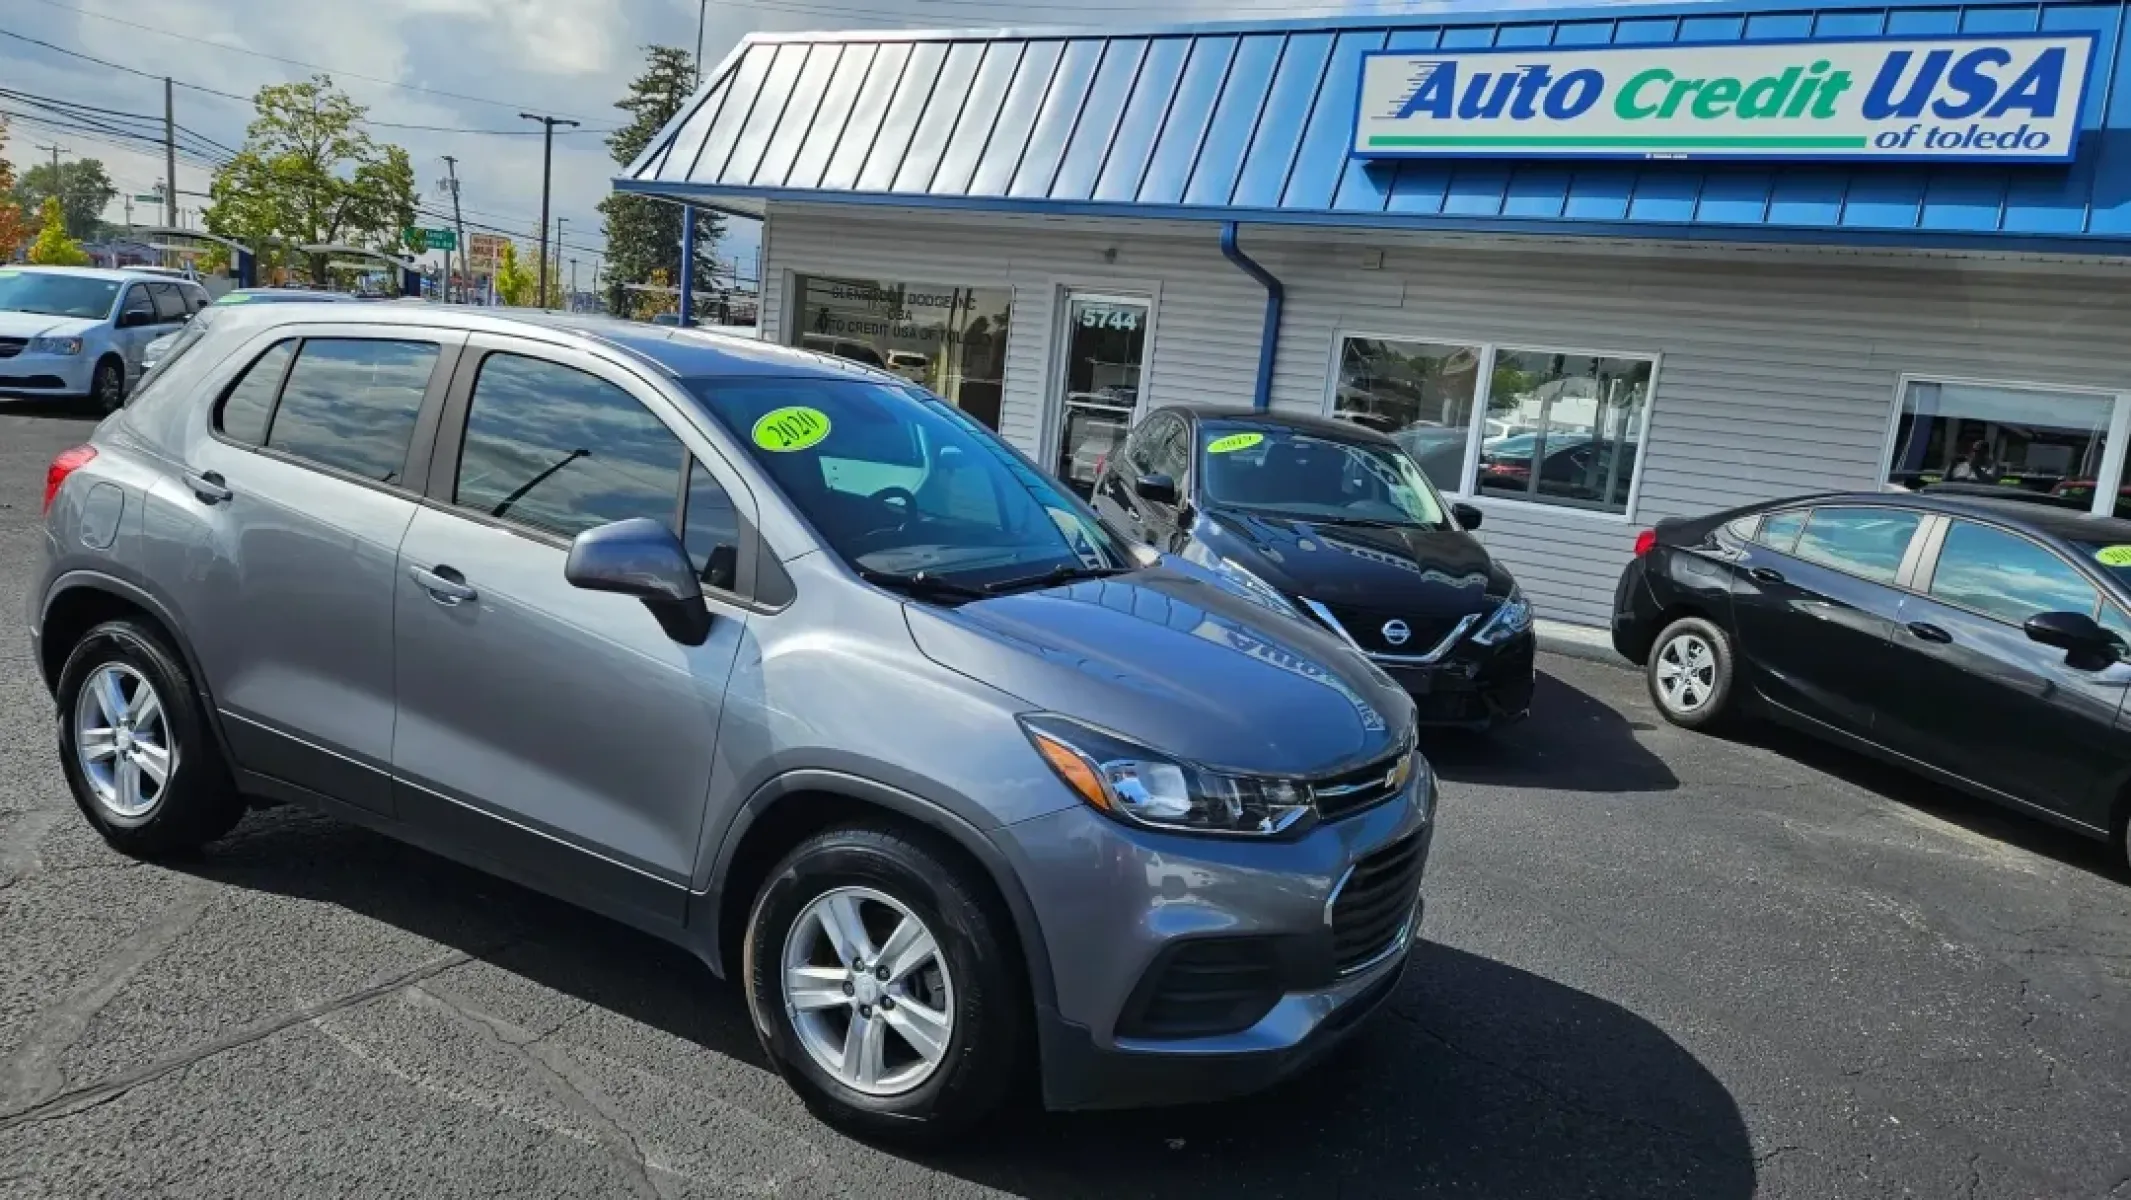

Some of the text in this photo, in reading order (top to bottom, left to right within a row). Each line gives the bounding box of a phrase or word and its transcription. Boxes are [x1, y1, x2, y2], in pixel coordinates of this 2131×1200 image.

[1382, 46, 2067, 121] Auto Credit USA
[1874, 123, 2050, 150] of toledo
[907, 293, 952, 308] DODGE
[848, 320, 889, 337] CREDIT
[893, 325, 917, 339] USA
[919, 328, 938, 341] OF
[1082, 309, 1137, 331] 5744
[766, 410, 820, 447] 2020
